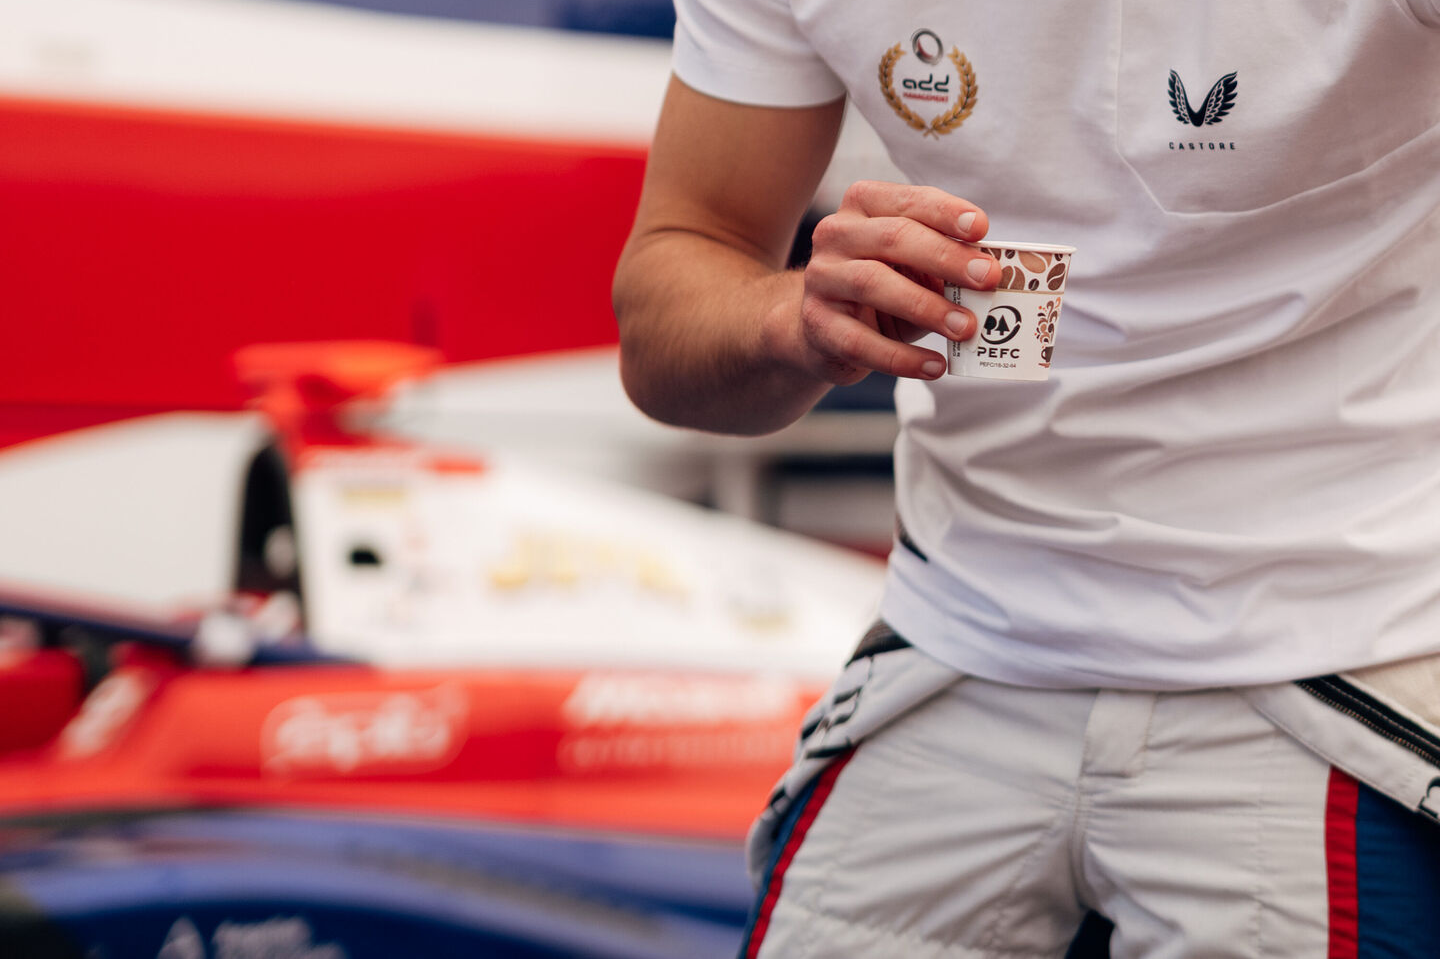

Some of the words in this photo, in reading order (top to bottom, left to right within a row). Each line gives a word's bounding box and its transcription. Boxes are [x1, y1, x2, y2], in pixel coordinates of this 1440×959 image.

[902, 73, 950, 92] add
[1168, 141, 1236, 150] CASTORE
[977, 346, 1020, 359] PEFC
